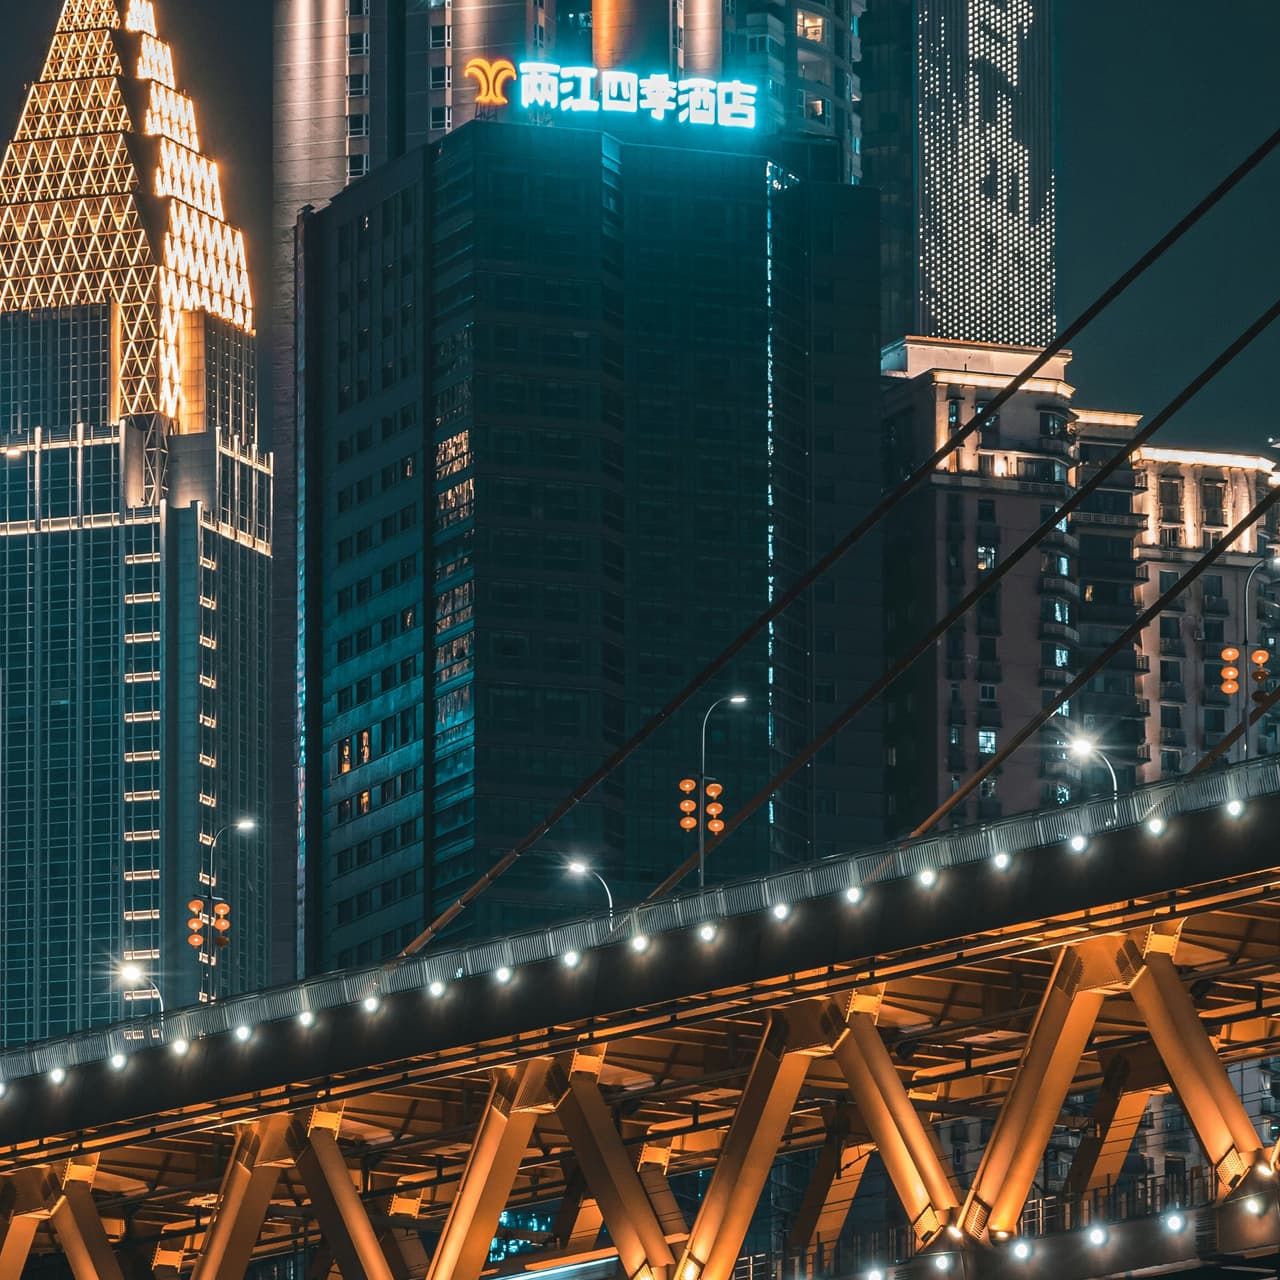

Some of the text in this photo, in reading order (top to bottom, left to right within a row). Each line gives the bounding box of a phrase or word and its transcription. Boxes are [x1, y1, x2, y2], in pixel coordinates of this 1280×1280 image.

[518, 61, 758, 129] 两江四季酒店
